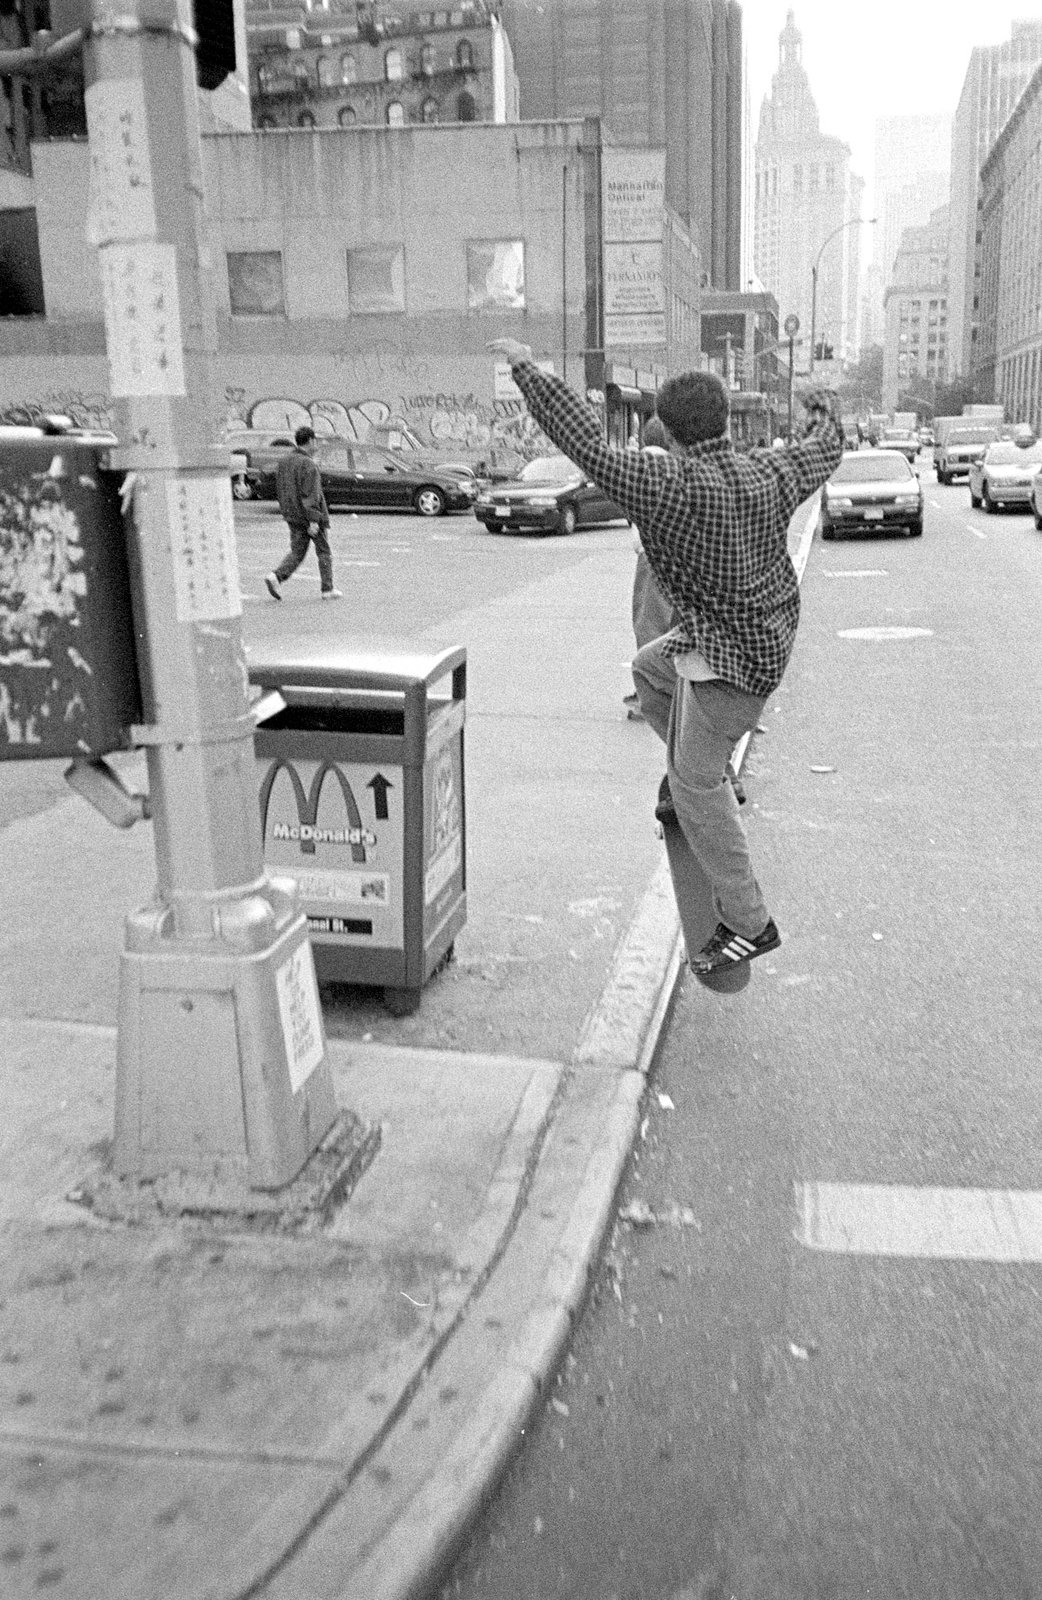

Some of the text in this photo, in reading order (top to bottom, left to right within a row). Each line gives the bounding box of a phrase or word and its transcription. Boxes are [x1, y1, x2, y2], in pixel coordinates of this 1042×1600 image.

[608, 181, 664, 190] Manhattan
[608, 193, 645, 203] Optical
[273, 824, 377, 845] McDonald's
